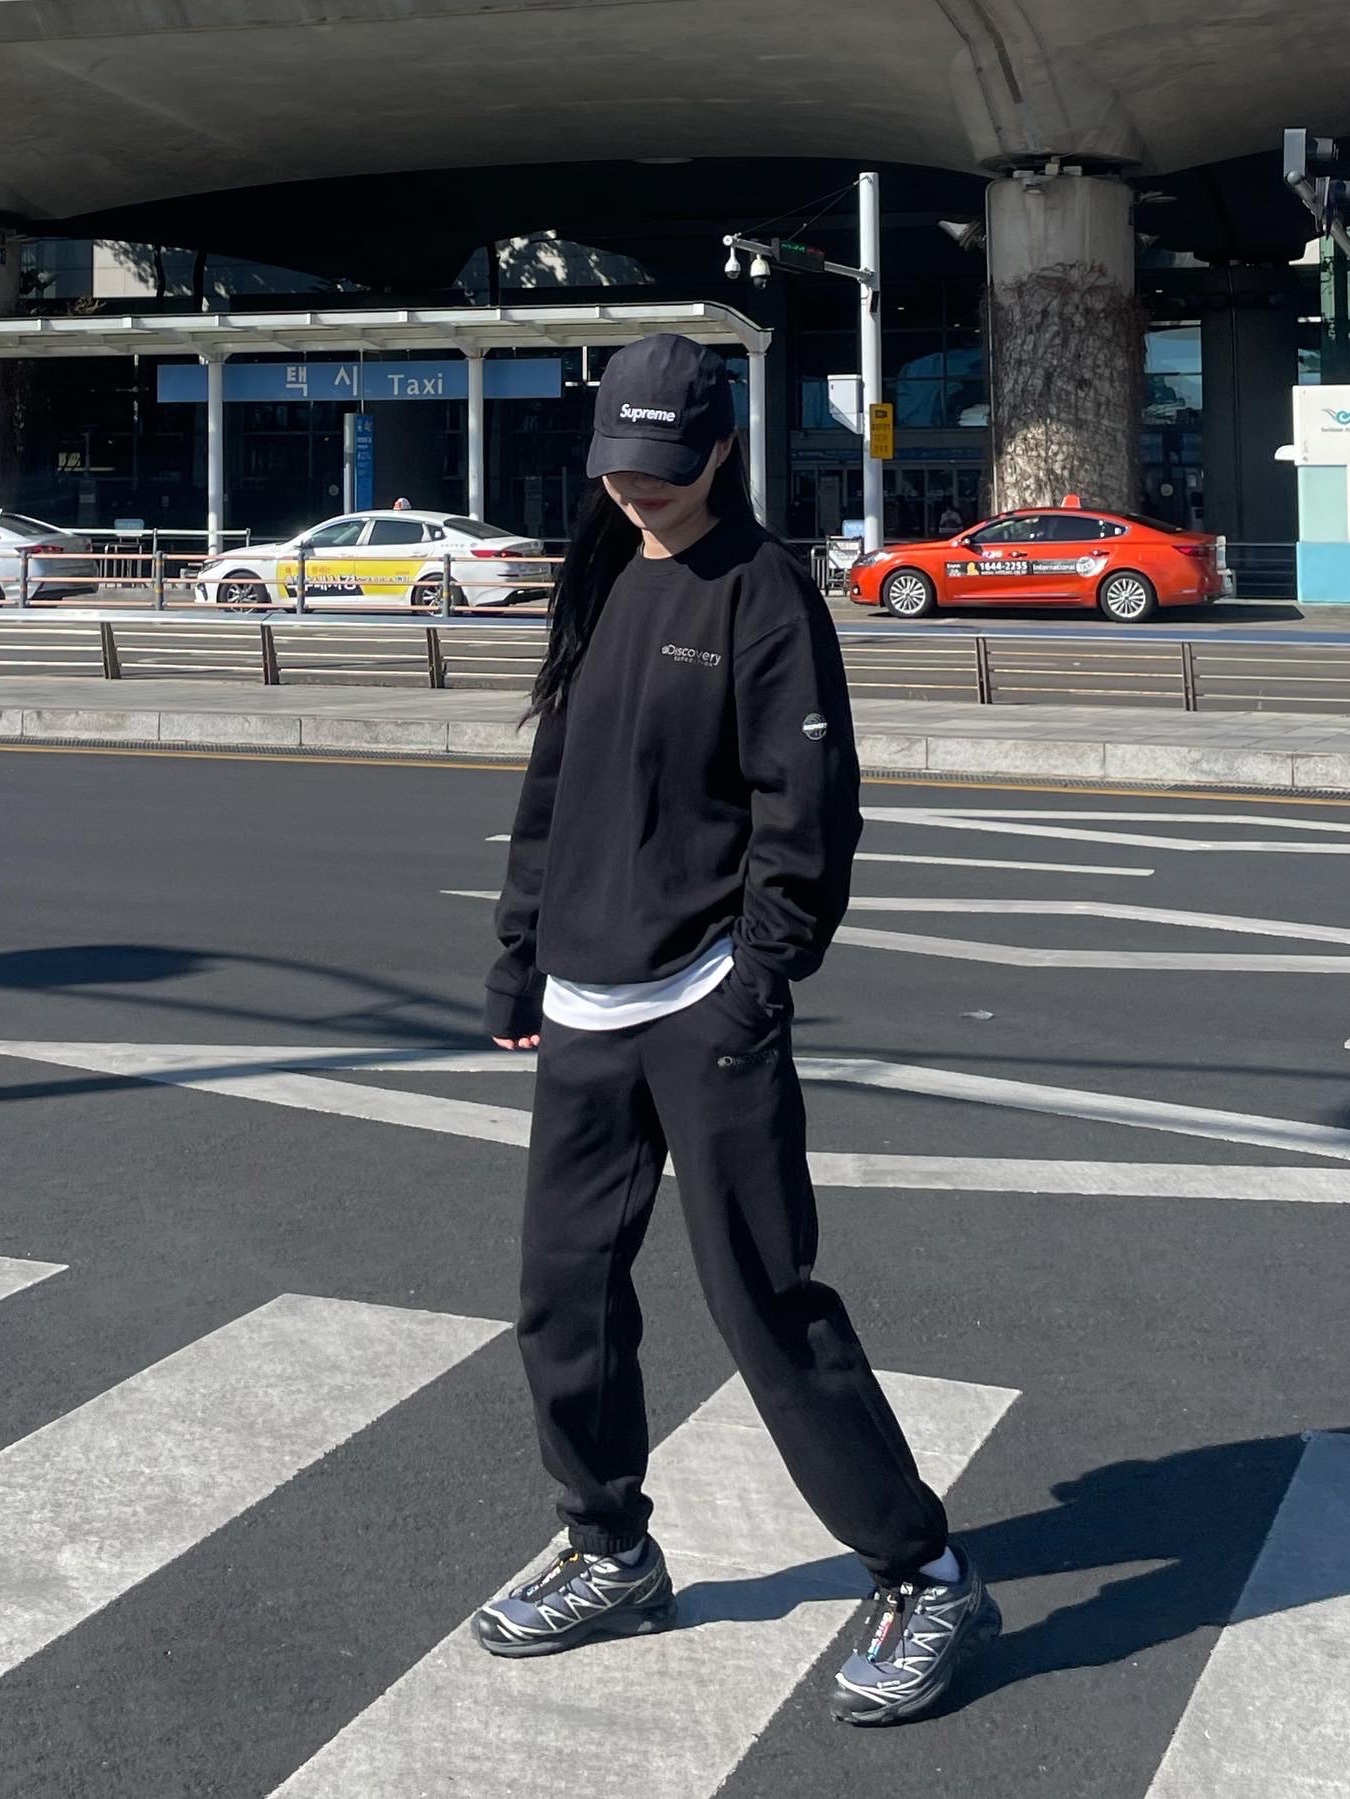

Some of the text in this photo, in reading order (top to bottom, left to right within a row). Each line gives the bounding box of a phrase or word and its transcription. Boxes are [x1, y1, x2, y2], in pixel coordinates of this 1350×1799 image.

[387, 373, 444, 396] Taxi
[619, 403, 676, 422] Supreme
[979, 561, 1028, 571] 1644-2255
[1032, 563, 1076, 571] International
[666, 644, 722, 666] Discovery
